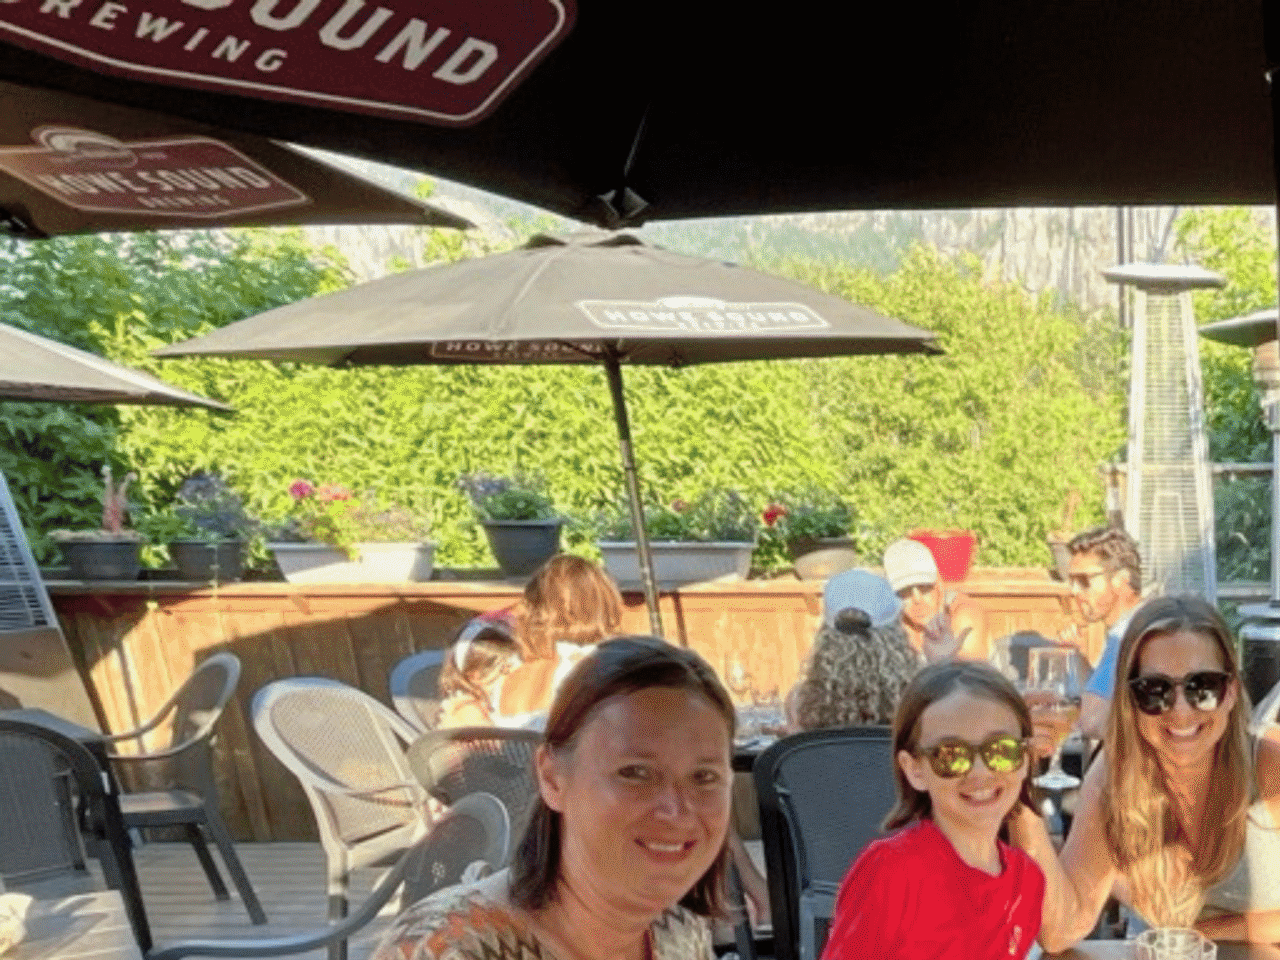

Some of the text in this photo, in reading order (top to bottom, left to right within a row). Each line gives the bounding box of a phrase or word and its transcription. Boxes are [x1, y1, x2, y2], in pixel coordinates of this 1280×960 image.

[0, 0, 288, 72] REWING
[180, 0, 499, 85] OUND
[36, 167, 271, 195] HOWE SOUND
